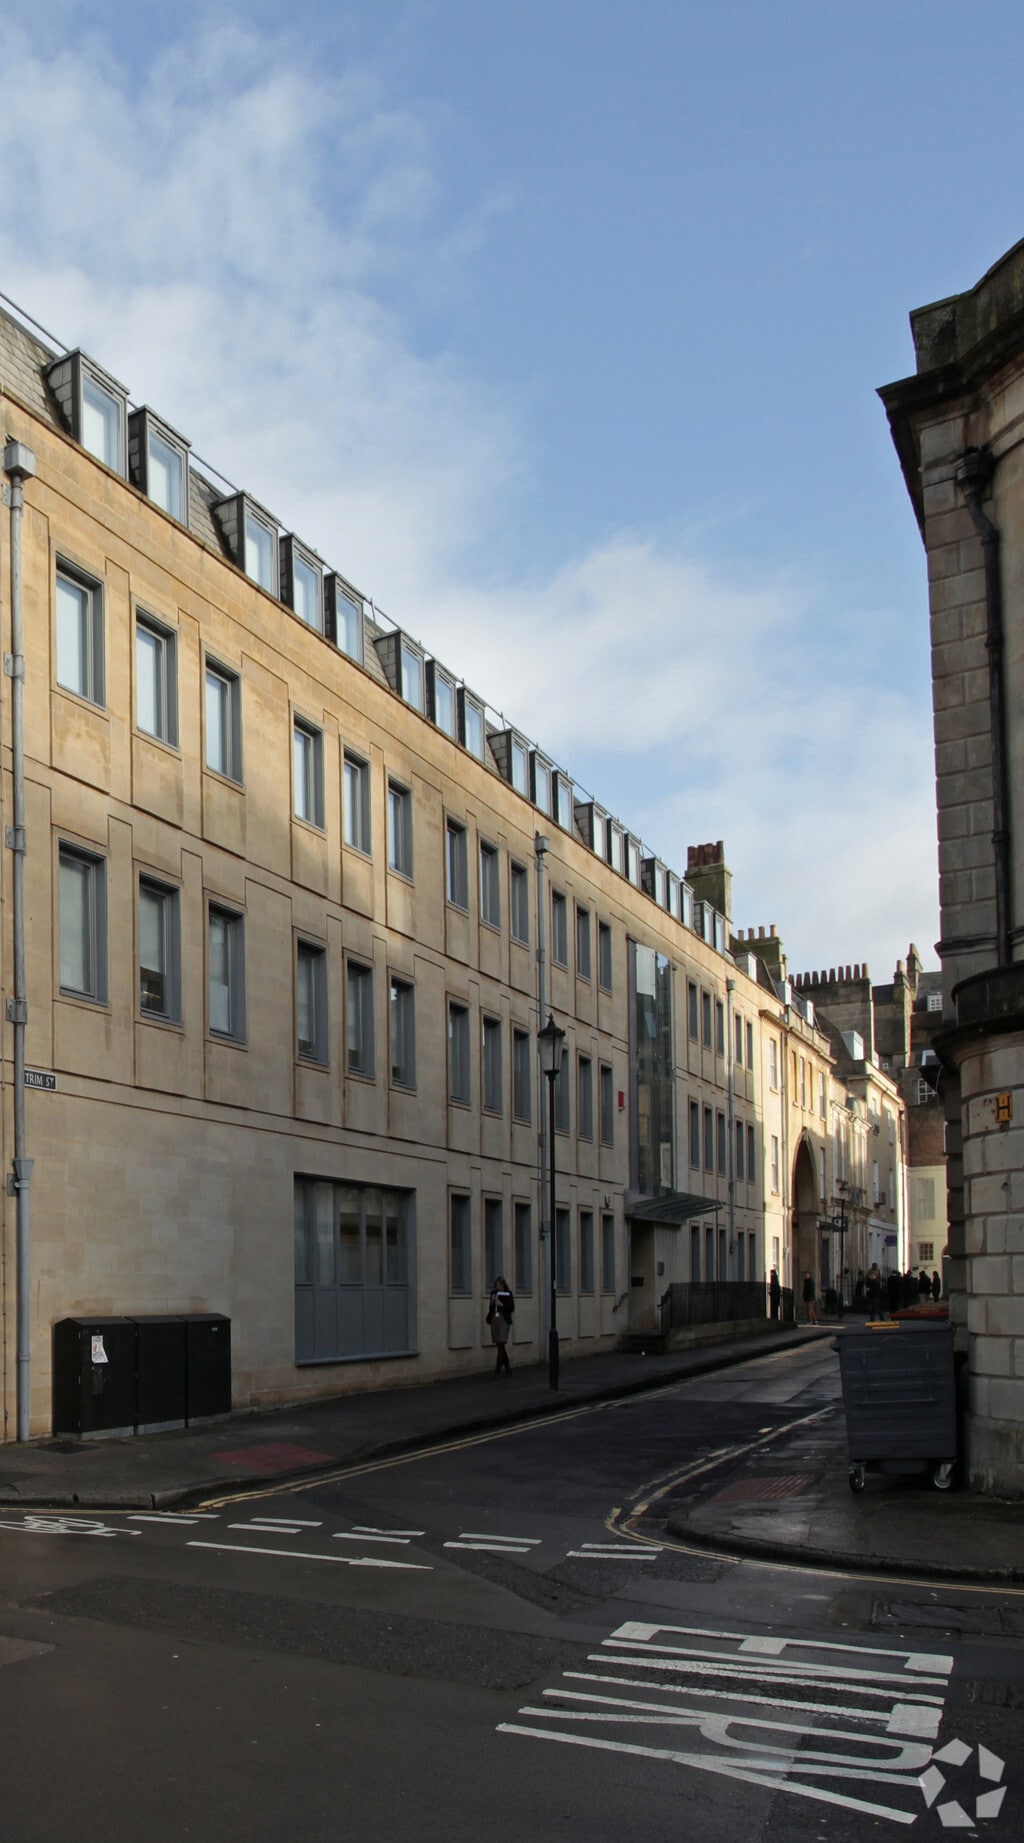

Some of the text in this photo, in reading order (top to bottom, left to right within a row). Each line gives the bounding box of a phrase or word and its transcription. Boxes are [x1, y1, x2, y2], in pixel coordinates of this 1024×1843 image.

[25, 1073, 55, 1087] TRIM ST
[495, 1620, 954, 1825] ENTRY
